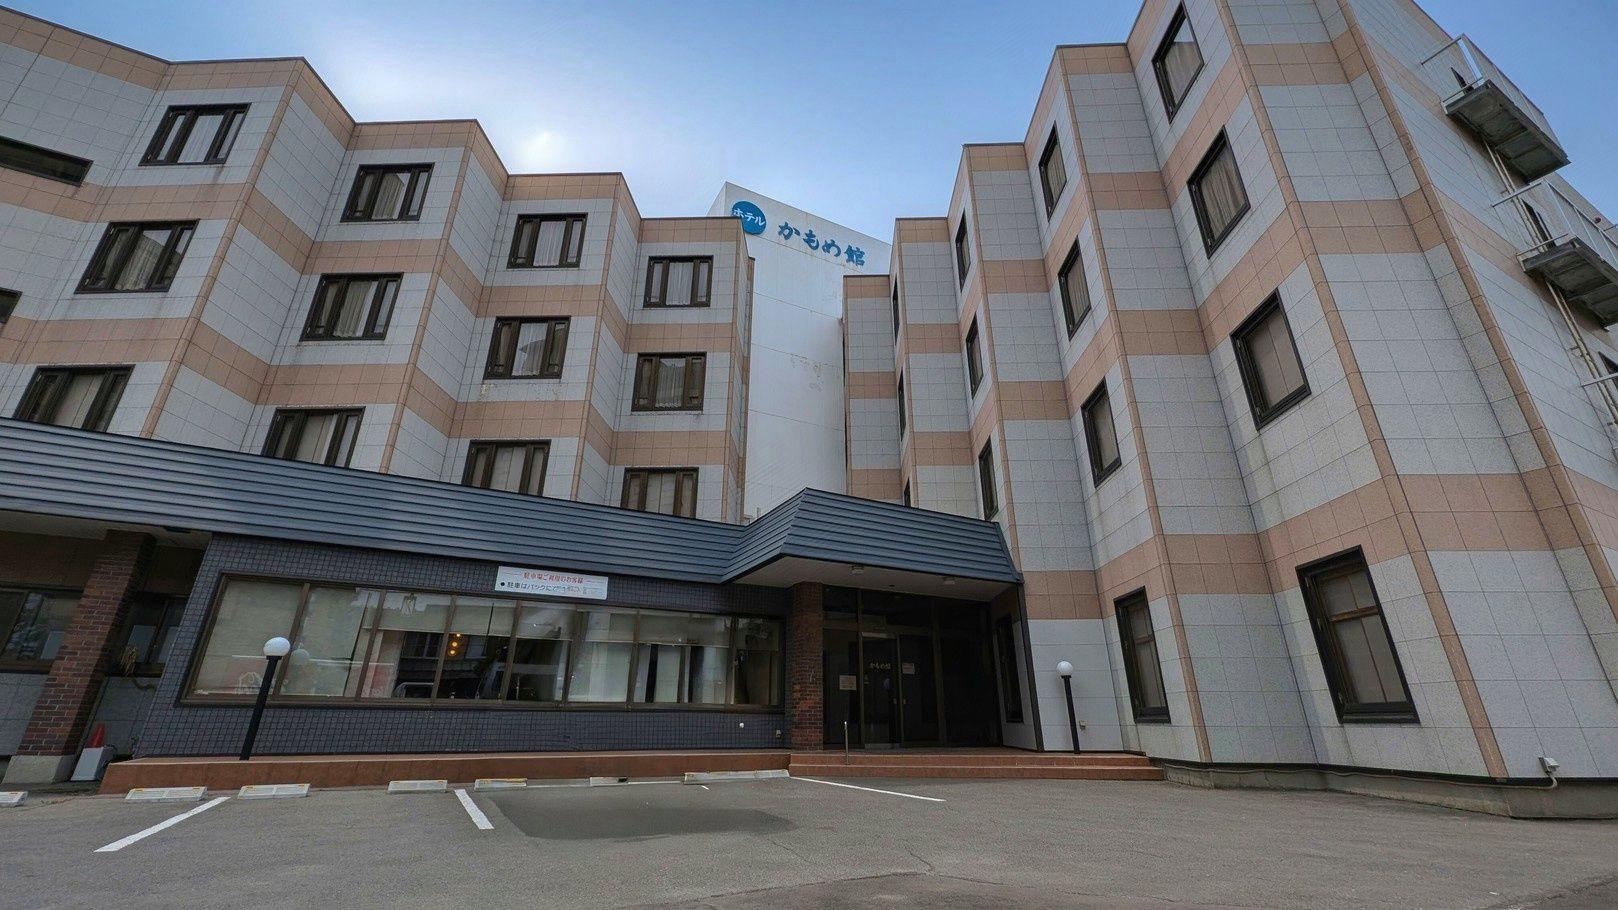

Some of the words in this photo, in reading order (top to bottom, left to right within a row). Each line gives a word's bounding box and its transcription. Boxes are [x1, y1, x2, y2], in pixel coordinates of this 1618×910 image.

[733, 208, 766, 226] ホテル
[778, 221, 866, 267] かもめ館
